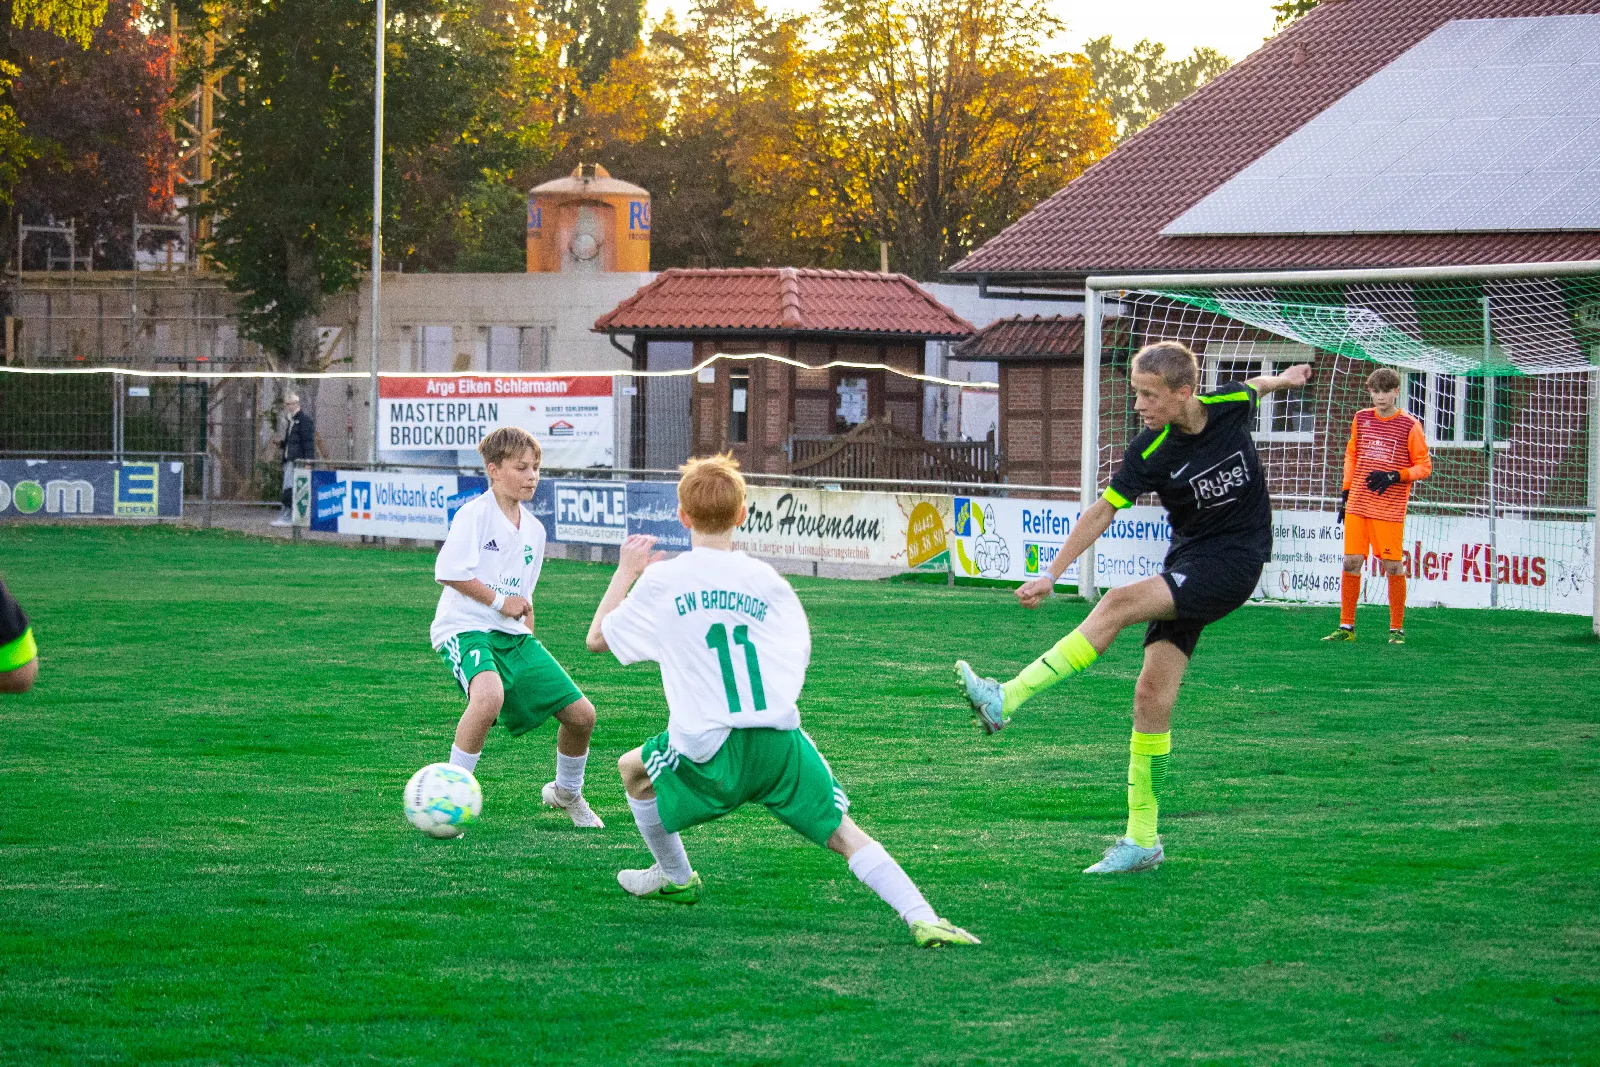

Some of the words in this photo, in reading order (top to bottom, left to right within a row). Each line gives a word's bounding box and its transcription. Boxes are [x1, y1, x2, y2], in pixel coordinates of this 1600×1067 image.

[426, 378, 455, 396] Arge
[458, 378, 492, 394] Eiken
[494, 378, 567, 393] Schlarmann
[390, 402, 499, 423] MASTERPLAN
[390, 425, 487, 446] BROCKDORF
[374, 481, 428, 509] Volksbank
[430, 486, 444, 508] eG
[117, 506, 155, 515] EDEKA
[777, 493, 881, 542] Hövemann
[1022, 508, 1070, 535] Reifen
[1292, 525, 1316, 539] Klaus
[558, 526, 625, 540] DACHBAUSTOFFE
[1097, 553, 1135, 576] Bernd
[1462, 543, 1548, 587] Klaus
[1291, 573, 1320, 591] 05494
[675, 592, 697, 616] GW
[469, 649, 481, 668] 7
[704, 622, 768, 714] 11
